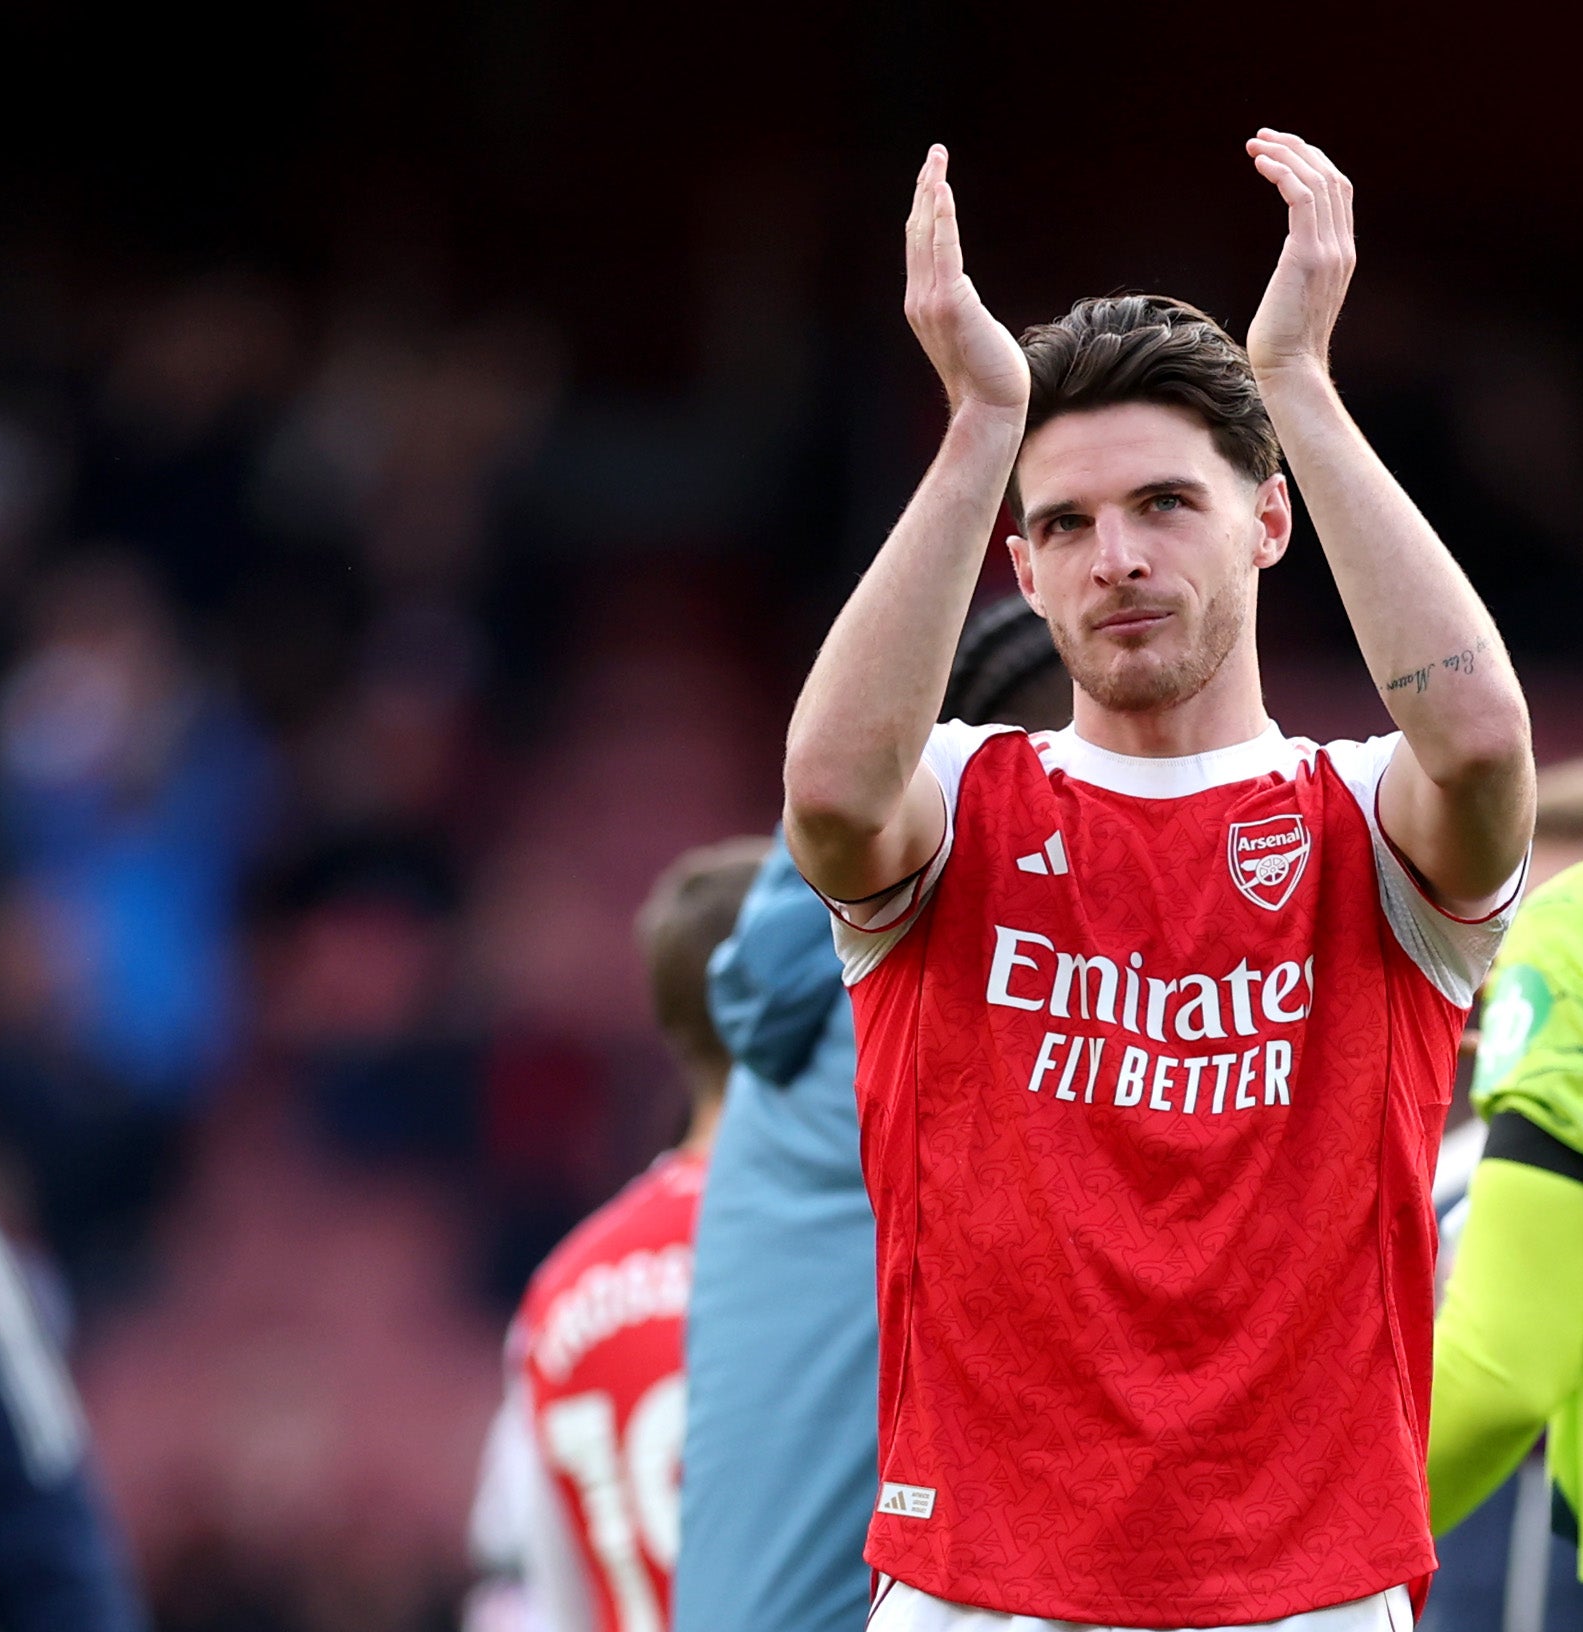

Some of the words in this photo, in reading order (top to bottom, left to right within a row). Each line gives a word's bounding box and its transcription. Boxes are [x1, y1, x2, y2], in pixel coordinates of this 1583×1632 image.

[1238, 826, 1301, 852] Arsenal
[1028, 1031, 1106, 1104] FLY
[1113, 1039, 1293, 1115] BETTER
